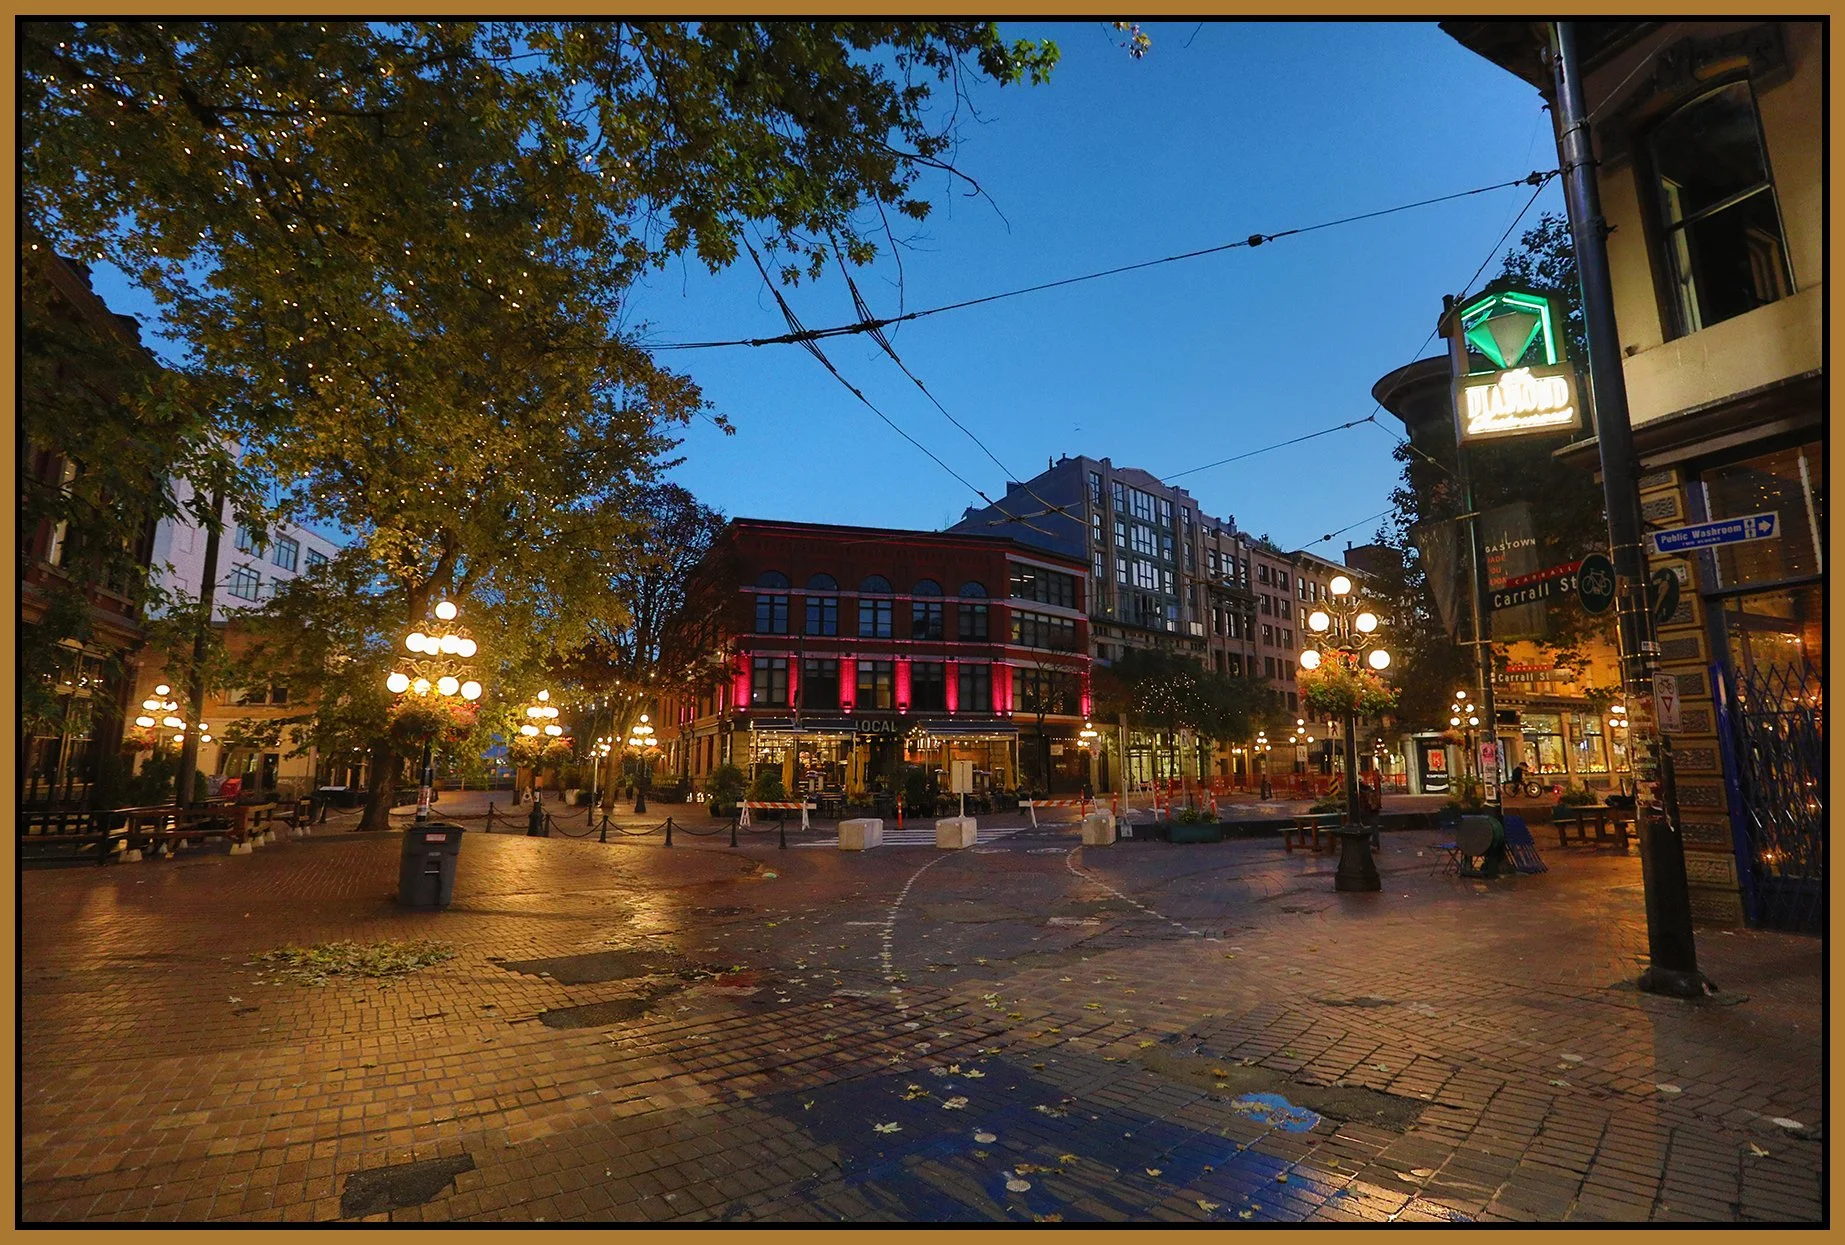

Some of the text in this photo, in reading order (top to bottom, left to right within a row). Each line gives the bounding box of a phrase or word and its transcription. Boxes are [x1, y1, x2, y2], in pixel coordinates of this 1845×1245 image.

[1661, 525, 1742, 544] Public Washroom
[1485, 538, 1536, 553] GASTOWN
[1515, 565, 1573, 584] CARRALL
[1494, 575, 1577, 608] Carrall St
[1498, 672, 1550, 682] Carrall St
[855, 720, 897, 732] LOCAL
